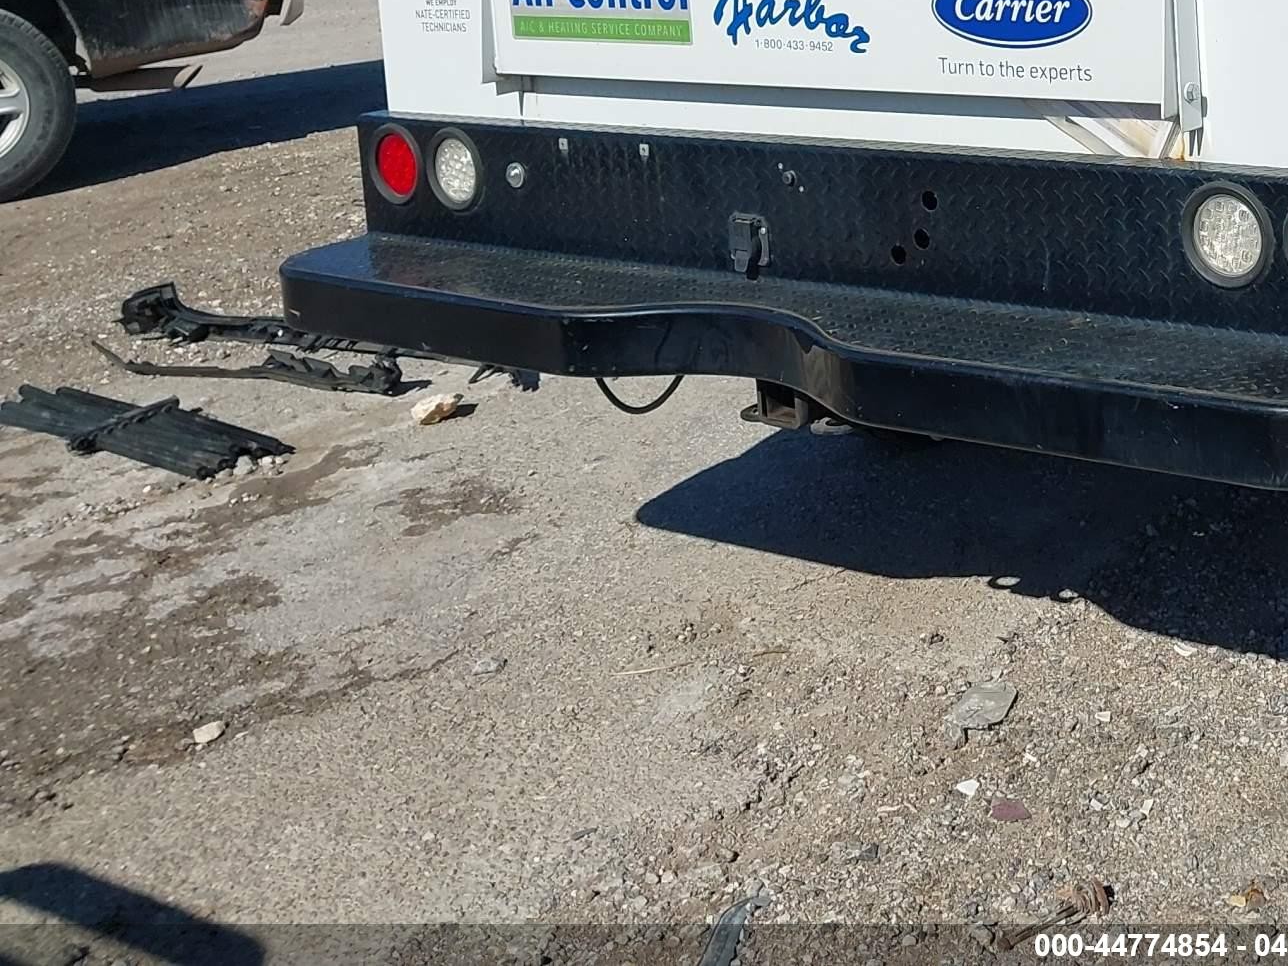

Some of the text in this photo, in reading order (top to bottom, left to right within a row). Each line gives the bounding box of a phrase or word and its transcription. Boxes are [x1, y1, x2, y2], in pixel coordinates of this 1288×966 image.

[415, 9, 471, 20] NATE-CERTIFIED
[421, 21, 467, 33] TECHNICIANS
[520, 20, 683, 37] A/C & HEATING SERVICE COMPANY
[938, 57, 1093, 84] Turn to the experts
